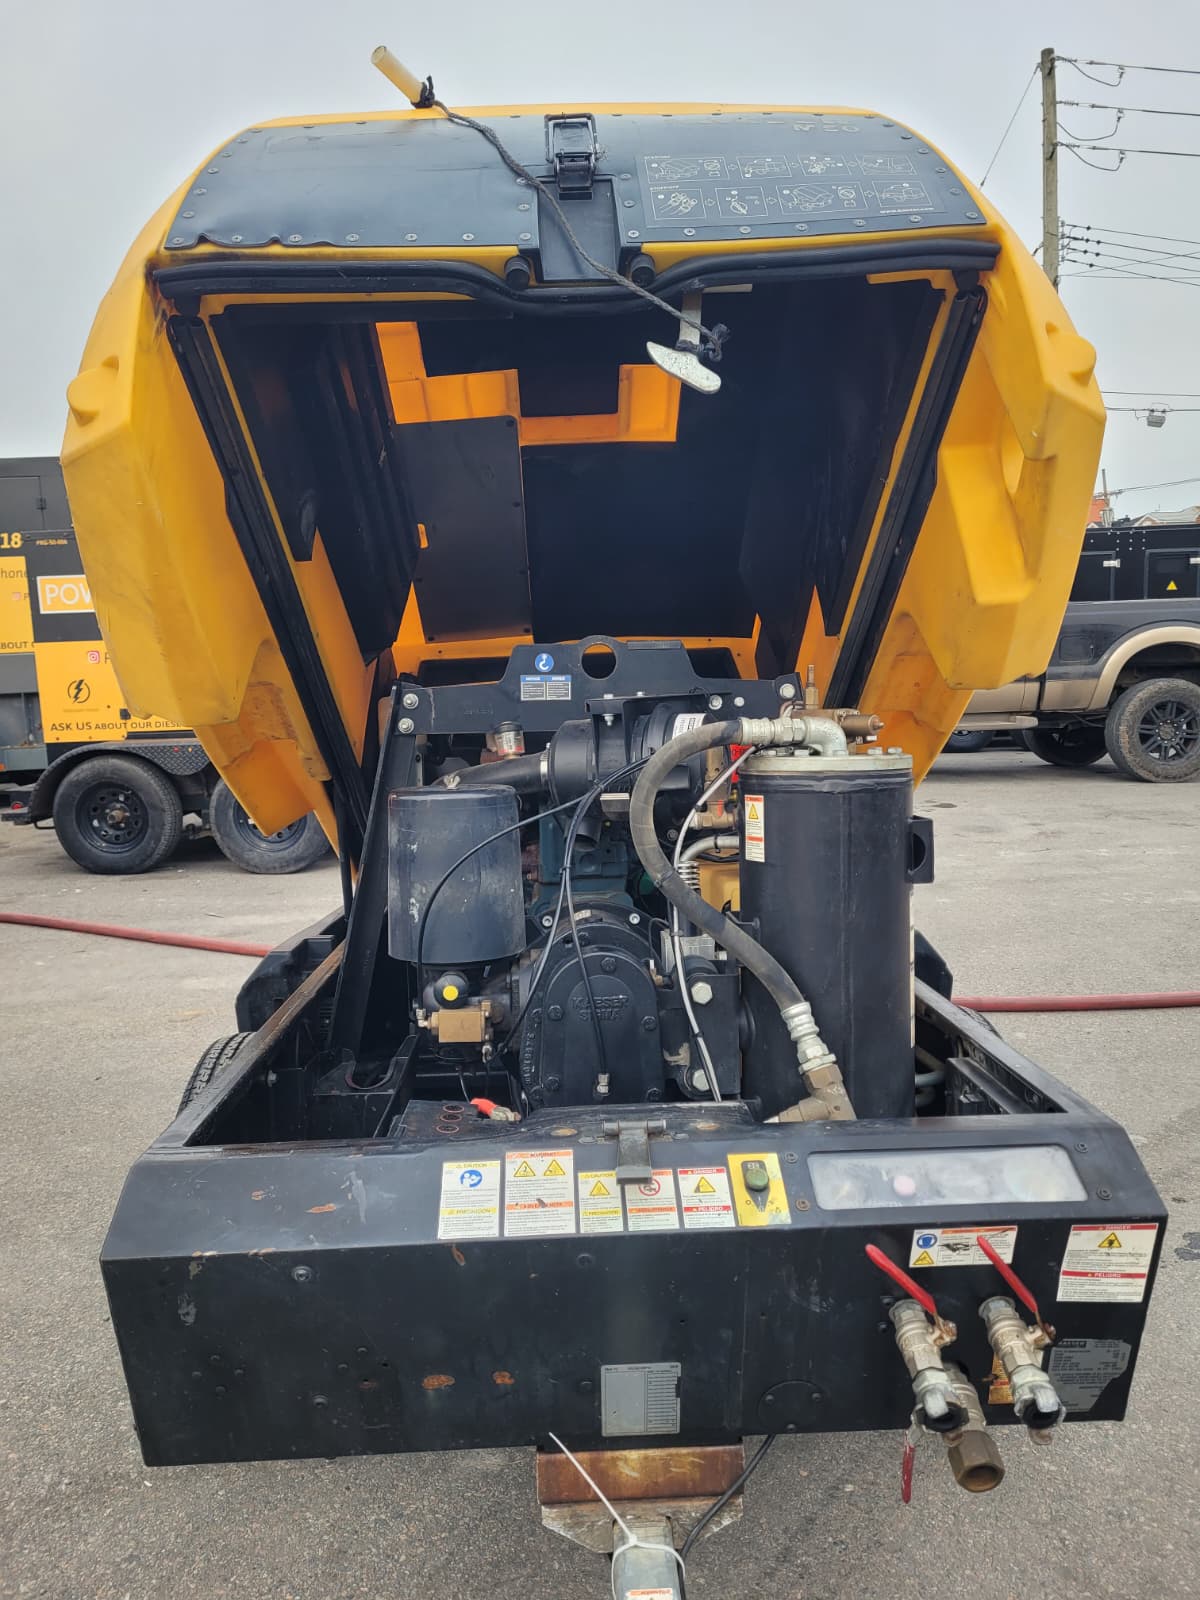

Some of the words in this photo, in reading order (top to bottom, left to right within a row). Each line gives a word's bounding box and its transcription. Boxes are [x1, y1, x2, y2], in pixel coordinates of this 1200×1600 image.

[0, 532, 22, 549] 18
[0, 641, 28, 650] BOUT
[51, 723, 73, 731] ASK
[76, 722, 92, 731] US
[95, 722, 127, 731] ABOUT
[131, 721, 152, 729] OUR
